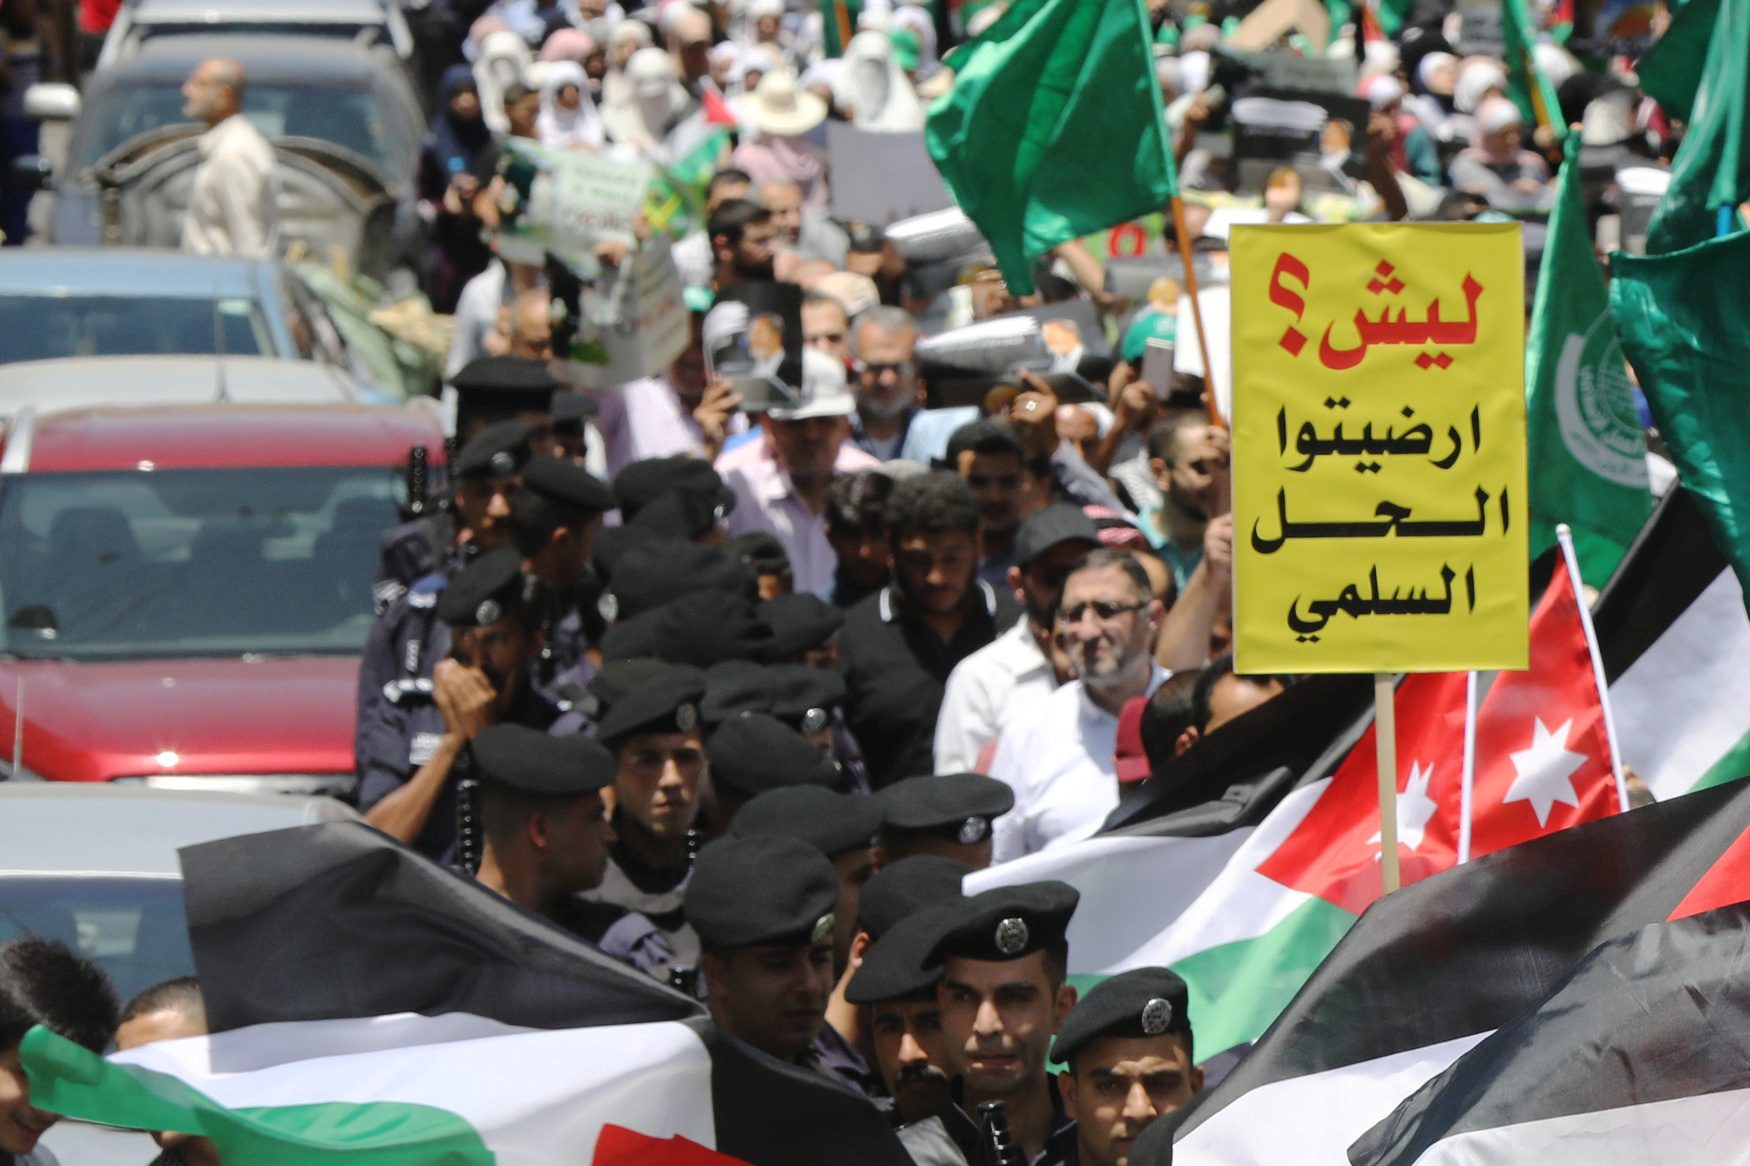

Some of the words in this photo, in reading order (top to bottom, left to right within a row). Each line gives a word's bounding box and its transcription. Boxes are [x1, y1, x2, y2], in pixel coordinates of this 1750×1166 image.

[1269, 252, 1484, 370] ليش؟
[1279, 397, 1482, 473] ارضيتوا
[1251, 487, 1511, 555] الحل
[1287, 564, 1476, 643] السلمي
